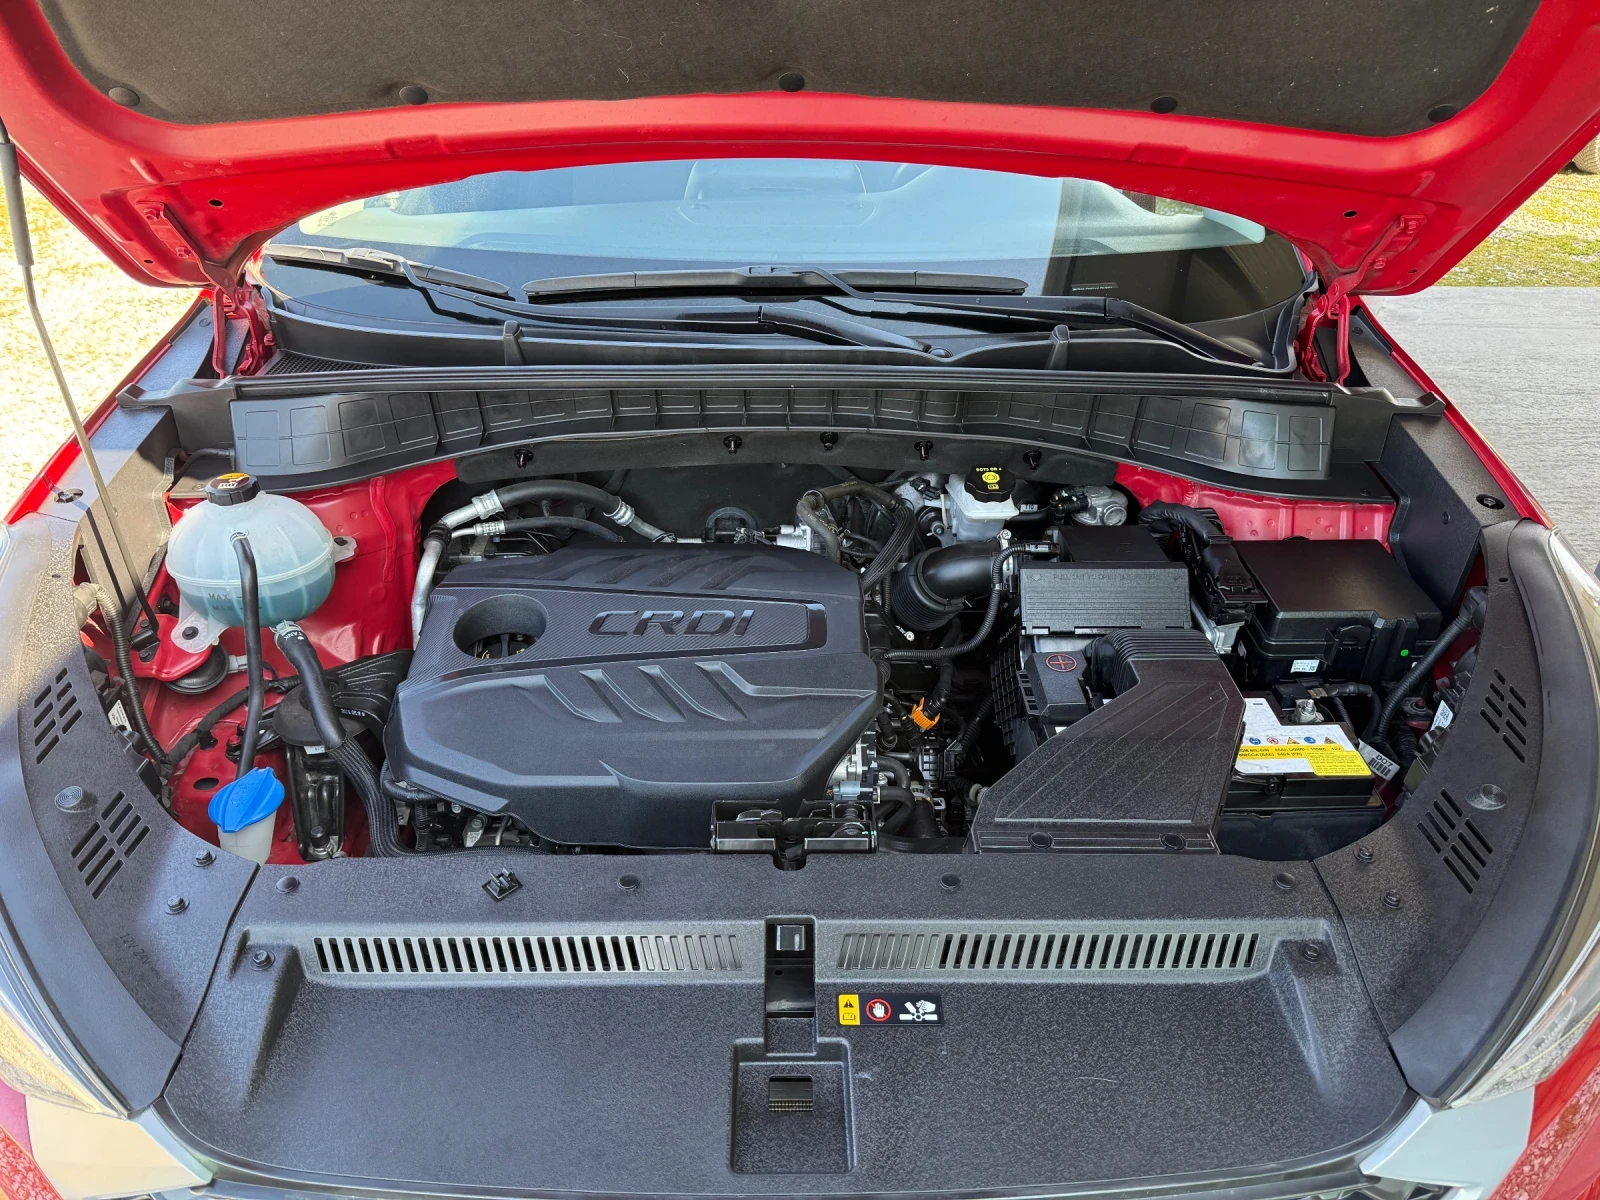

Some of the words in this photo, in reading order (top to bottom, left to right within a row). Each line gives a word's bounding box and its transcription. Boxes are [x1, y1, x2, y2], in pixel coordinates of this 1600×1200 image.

[284, 631, 302, 641] TANK
[588, 609, 755, 637] CRDI
[119, 933, 139, 949] 12V
[133, 948, 154, 965] 24V
